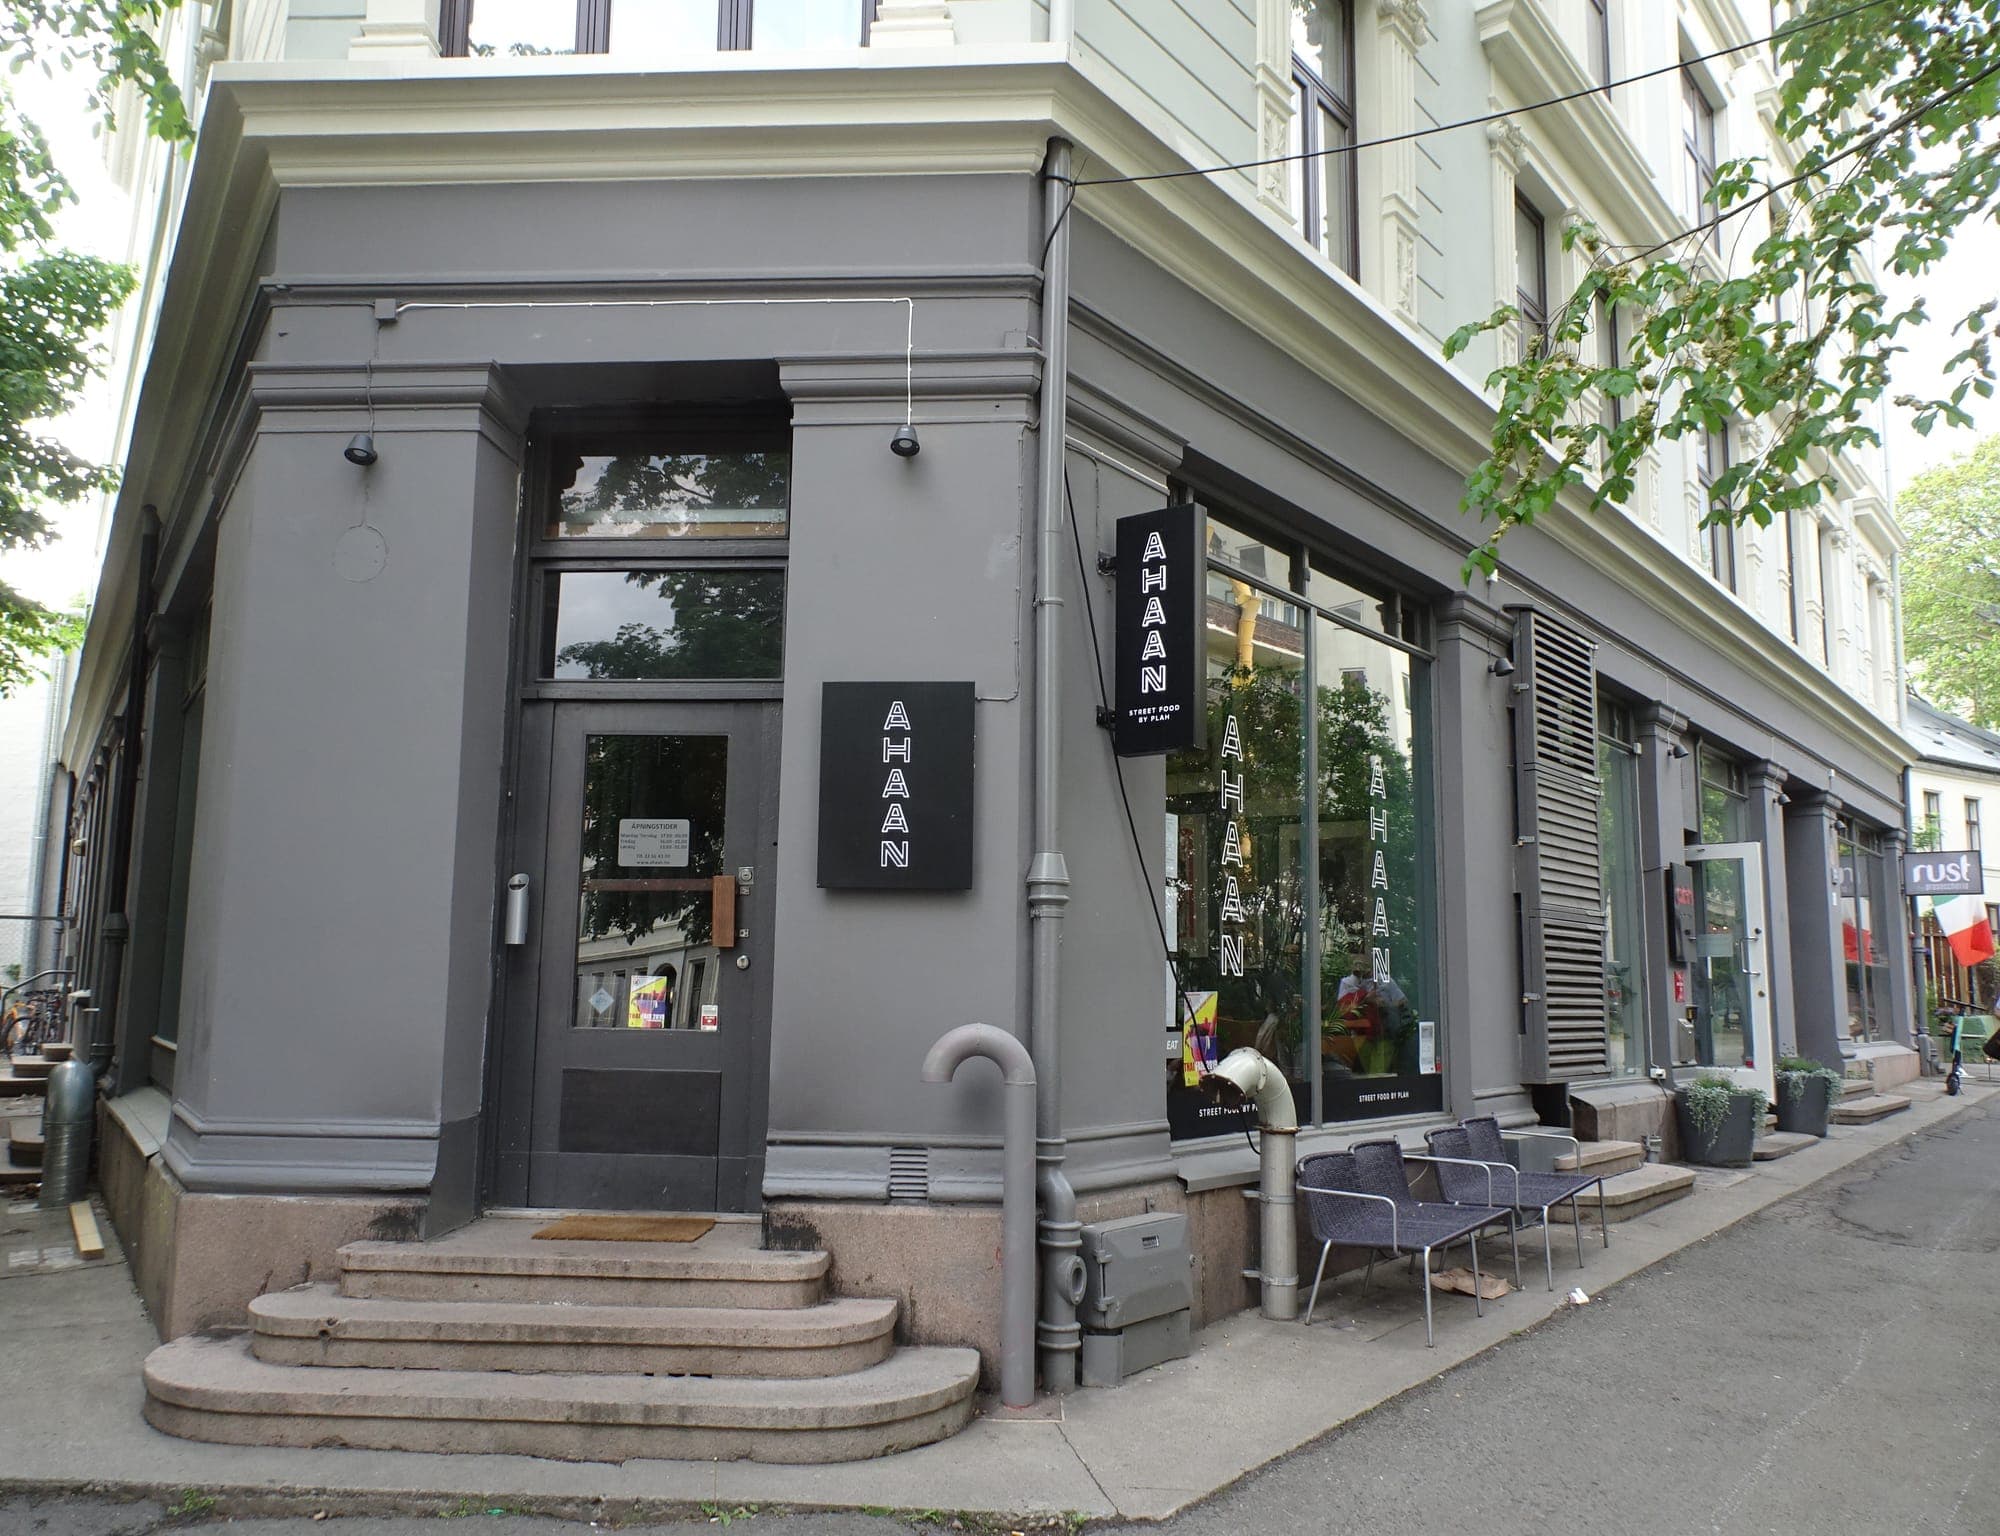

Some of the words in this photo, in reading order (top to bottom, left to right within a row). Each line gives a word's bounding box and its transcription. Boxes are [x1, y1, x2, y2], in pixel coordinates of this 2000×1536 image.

[1142, 532, 1167, 694] AHAAN
[1129, 707, 1156, 717] STREET
[1159, 704, 1180, 712] FOOD
[1150, 713, 1170, 722] PLAH
[881, 701, 911, 867] AHAAN
[1221, 715, 1244, 977] AHAAN
[1369, 760, 1390, 983] AHAAN
[1912, 854, 1971, 883] rust
[1166, 1040, 1179, 1050] EAT
[1359, 1093, 1376, 1103] STREET
[1377, 1092, 1390, 1101] FOOD
[1391, 1091, 1397, 1099] BY
[1199, 1107, 1222, 1117] STREET
